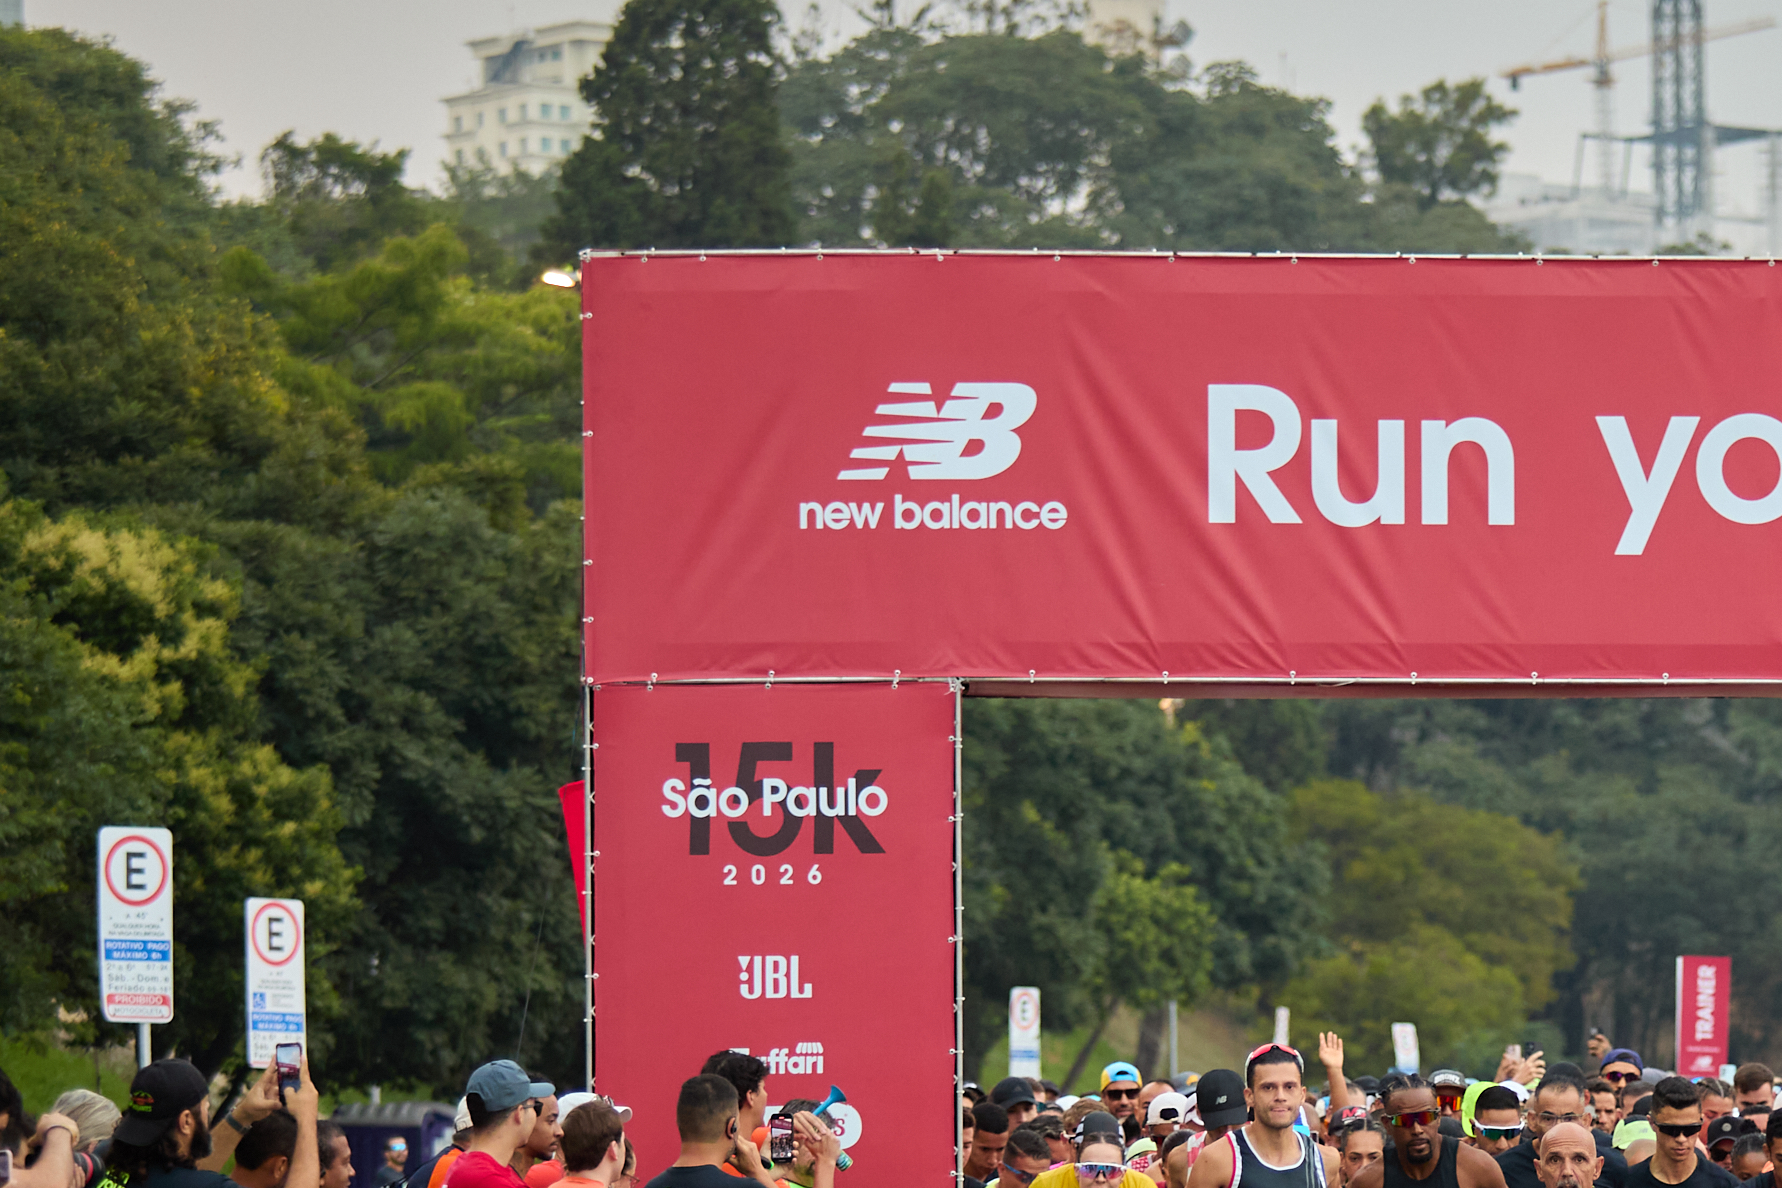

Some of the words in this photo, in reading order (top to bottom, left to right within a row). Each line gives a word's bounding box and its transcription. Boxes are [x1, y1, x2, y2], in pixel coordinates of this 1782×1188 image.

[1208, 384, 1515, 528] Run
[799, 501, 883, 530] new
[893, 494, 1068, 531] balance
[661, 776, 749, 818] São
[762, 776, 888, 817] Paulo
[675, 741, 886, 857] 15k
[126, 852, 148, 891] E
[723, 863, 822, 886] 2026
[106, 941, 144, 950] ROTATIVO
[147, 942, 170, 951] PAGO
[267, 917, 284, 952] E
[113, 950, 149, 960] MÁXIMO
[738, 955, 812, 999] JBL
[1694, 965, 1717, 1041] TRAINER
